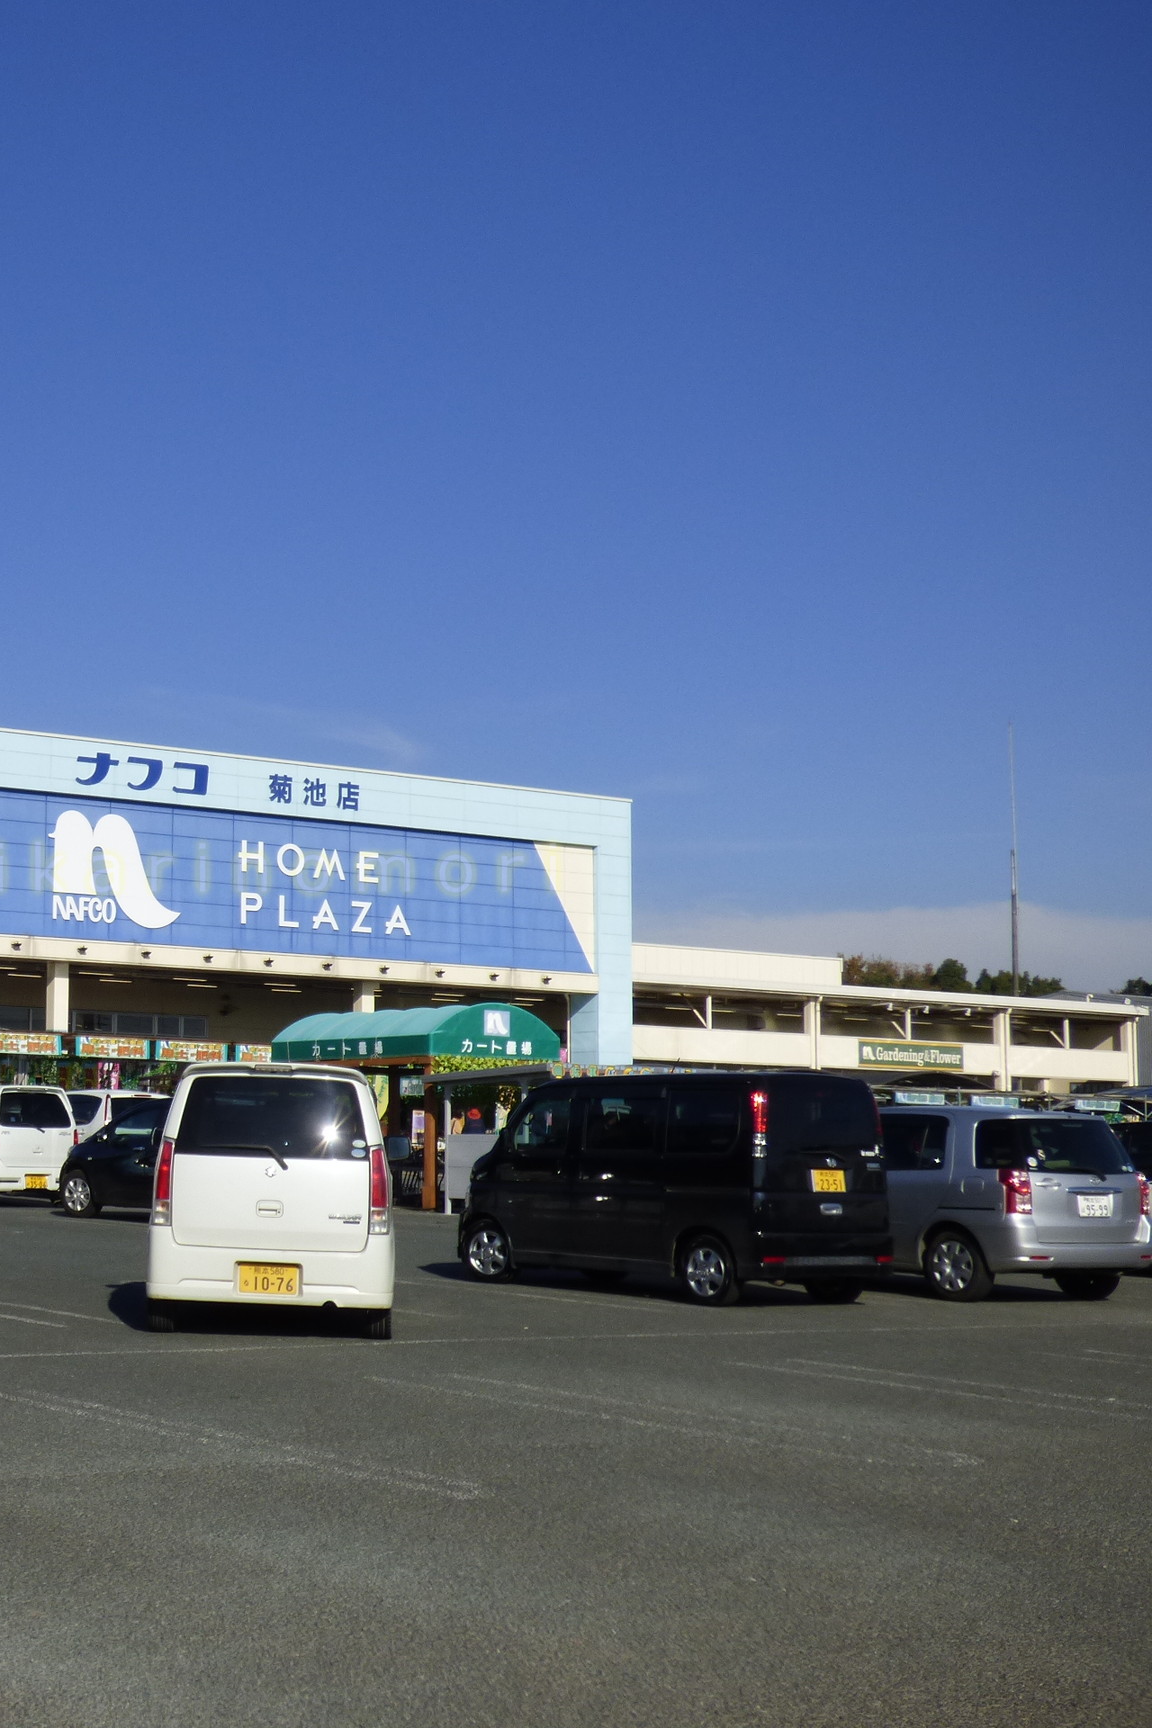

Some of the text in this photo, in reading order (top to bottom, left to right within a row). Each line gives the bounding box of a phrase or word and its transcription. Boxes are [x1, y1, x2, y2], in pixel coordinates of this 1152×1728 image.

[75, 752, 360, 812] ナフコ 菊池店
[238, 839, 380, 884] HOME
[52, 894, 117, 924] NAFCO
[240, 891, 412, 936] PLAZA
[312, 1041, 383, 1056] カート置場
[461, 1039, 532, 1055] カート置場
[820, 1178, 843, 1191] 23-51
[254, 1275, 294, 1292] 10-76
